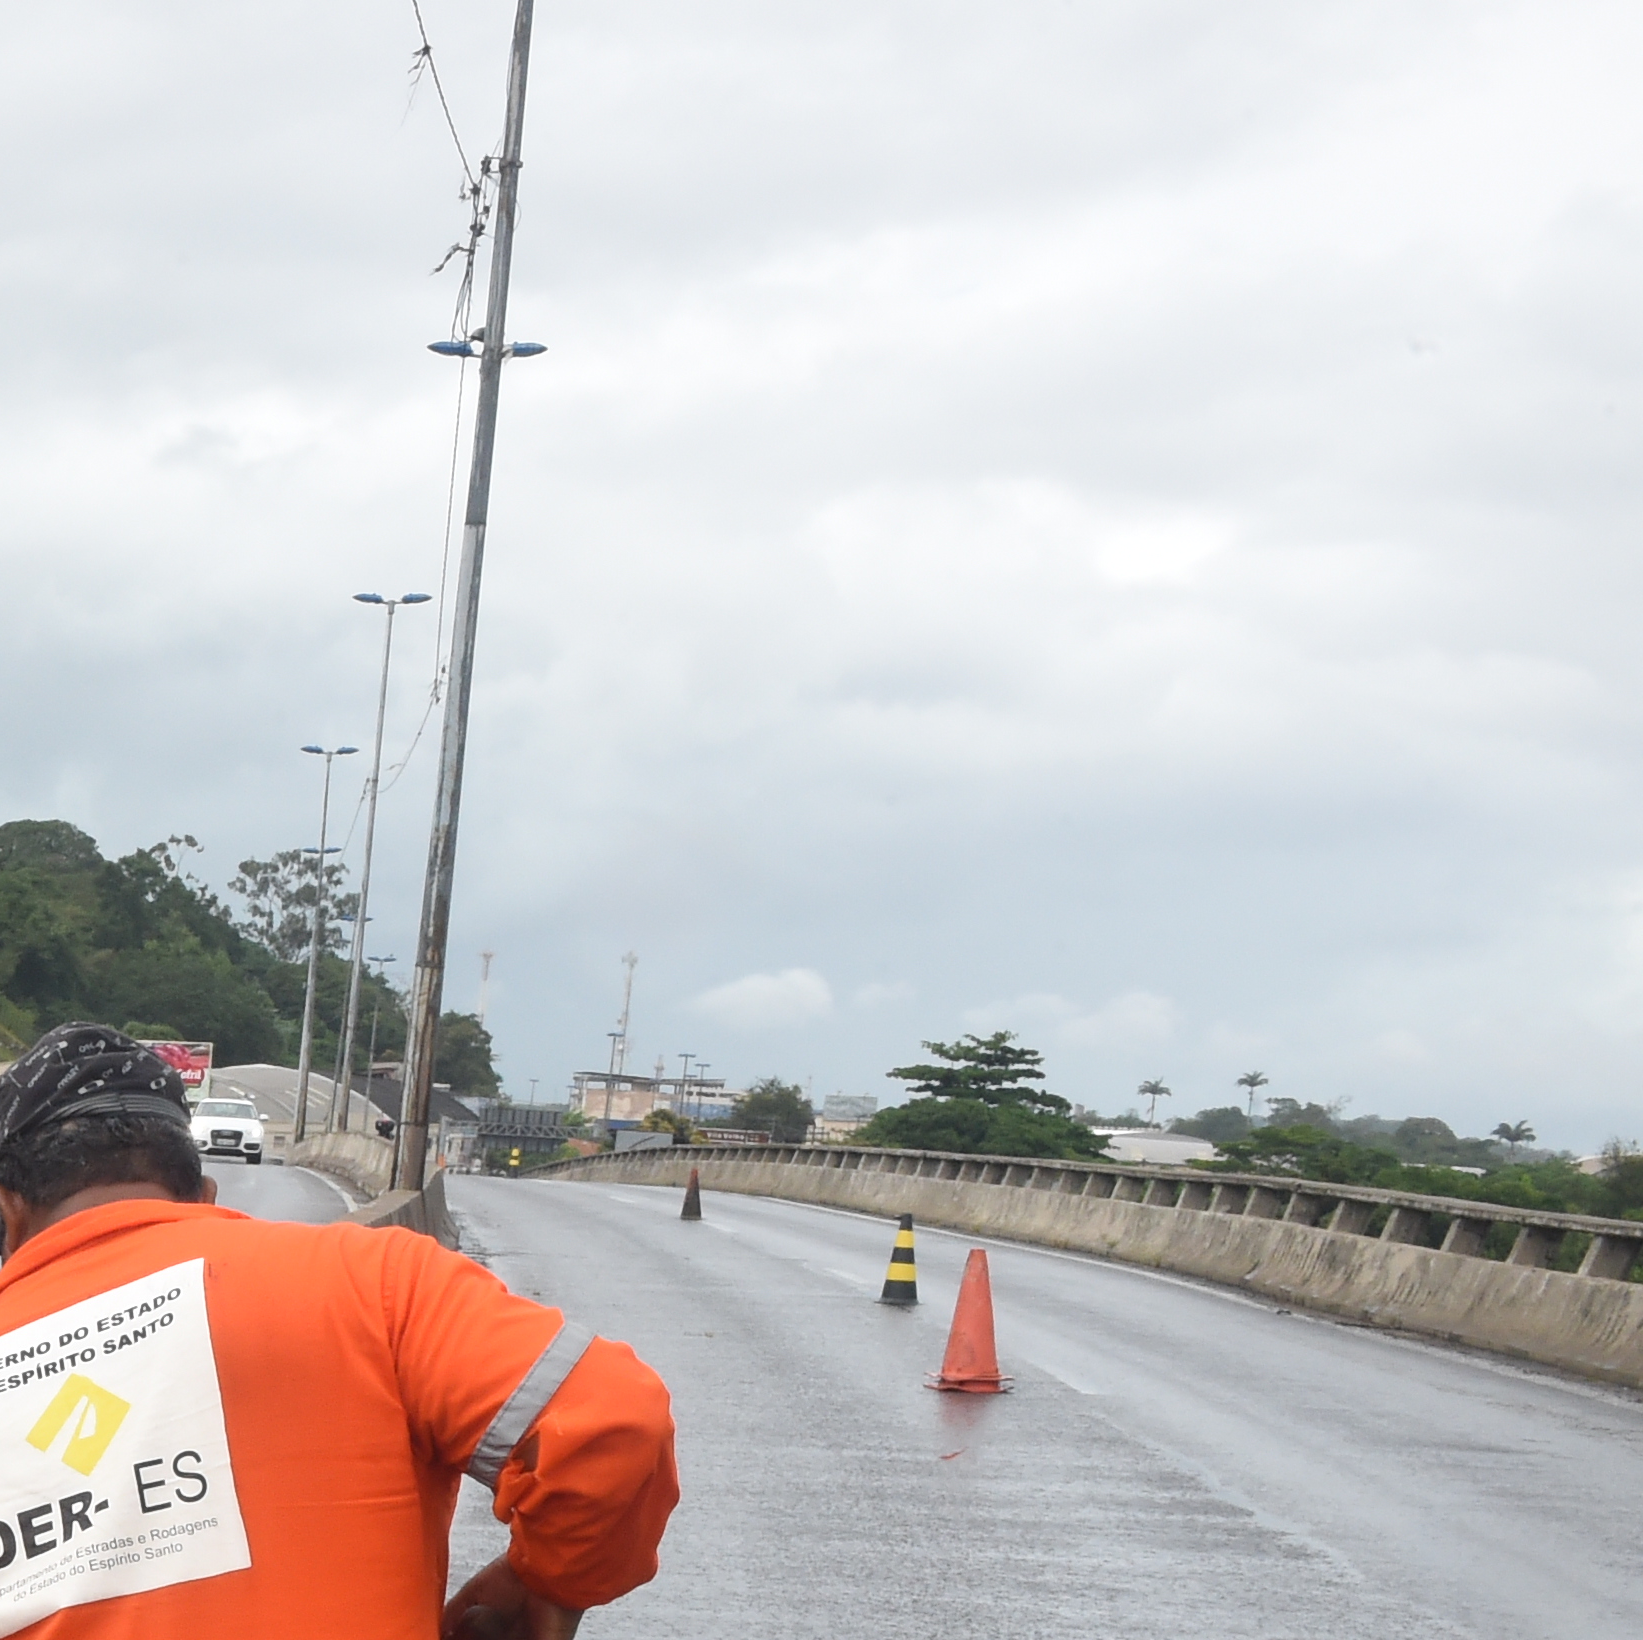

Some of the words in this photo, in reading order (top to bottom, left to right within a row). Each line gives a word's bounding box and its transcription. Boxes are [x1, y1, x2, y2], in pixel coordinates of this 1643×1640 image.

[59, 1326, 89, 1347] DO
[96, 1287, 181, 1333] ESTADO
[103, 1312, 174, 1354] SANTO
[133, 1450, 208, 1514] ES
[75, 1537, 134, 1559] Estradas
[137, 1535, 147, 1545] e
[150, 1516, 218, 1541] Rodagens
[29, 1573, 66, 1595] Estado
[69, 1564, 85, 1577] do
[89, 1552, 141, 1573] Espírito
[145, 1542, 183, 1560] Santo
